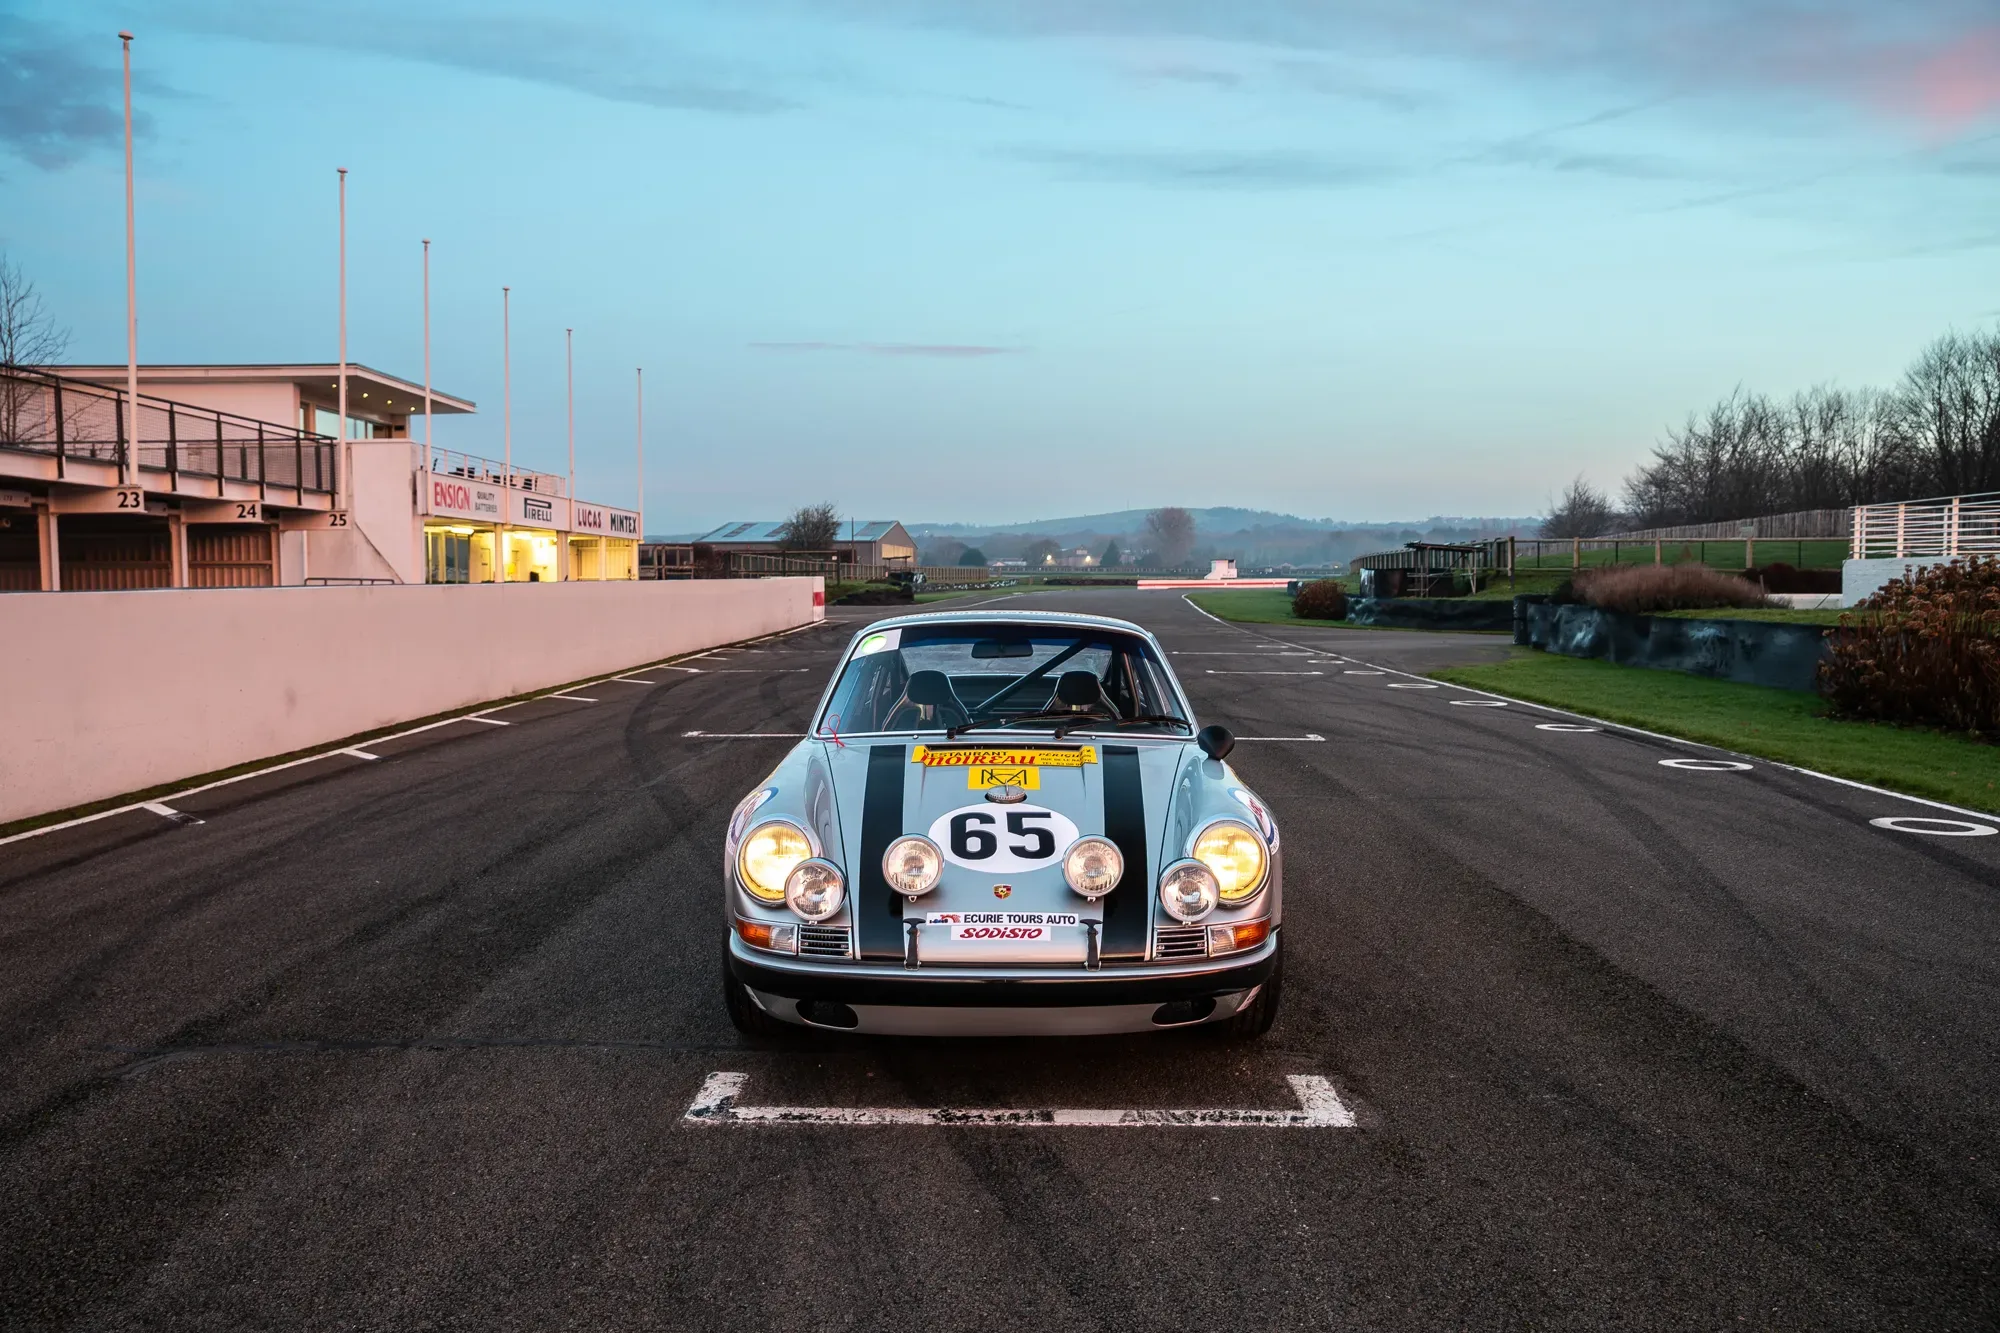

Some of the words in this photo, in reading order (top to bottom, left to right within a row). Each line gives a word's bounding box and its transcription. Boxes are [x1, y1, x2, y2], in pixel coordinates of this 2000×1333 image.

[117, 491, 141, 509] 23
[434, 481, 471, 512] ENSIGN
[477, 491, 495, 501] QUALITY
[236, 504, 257, 519] 24
[524, 497, 552, 523] PIRELLI
[329, 513, 347, 527] 25
[577, 508, 602, 529] LUCAS
[610, 512, 637, 534] MINTEX
[950, 811, 1056, 860] 65
[963, 913, 1004, 924] ECURIE
[1006, 914, 1043, 924] TOURS
[1046, 915, 1076, 925] AUTO
